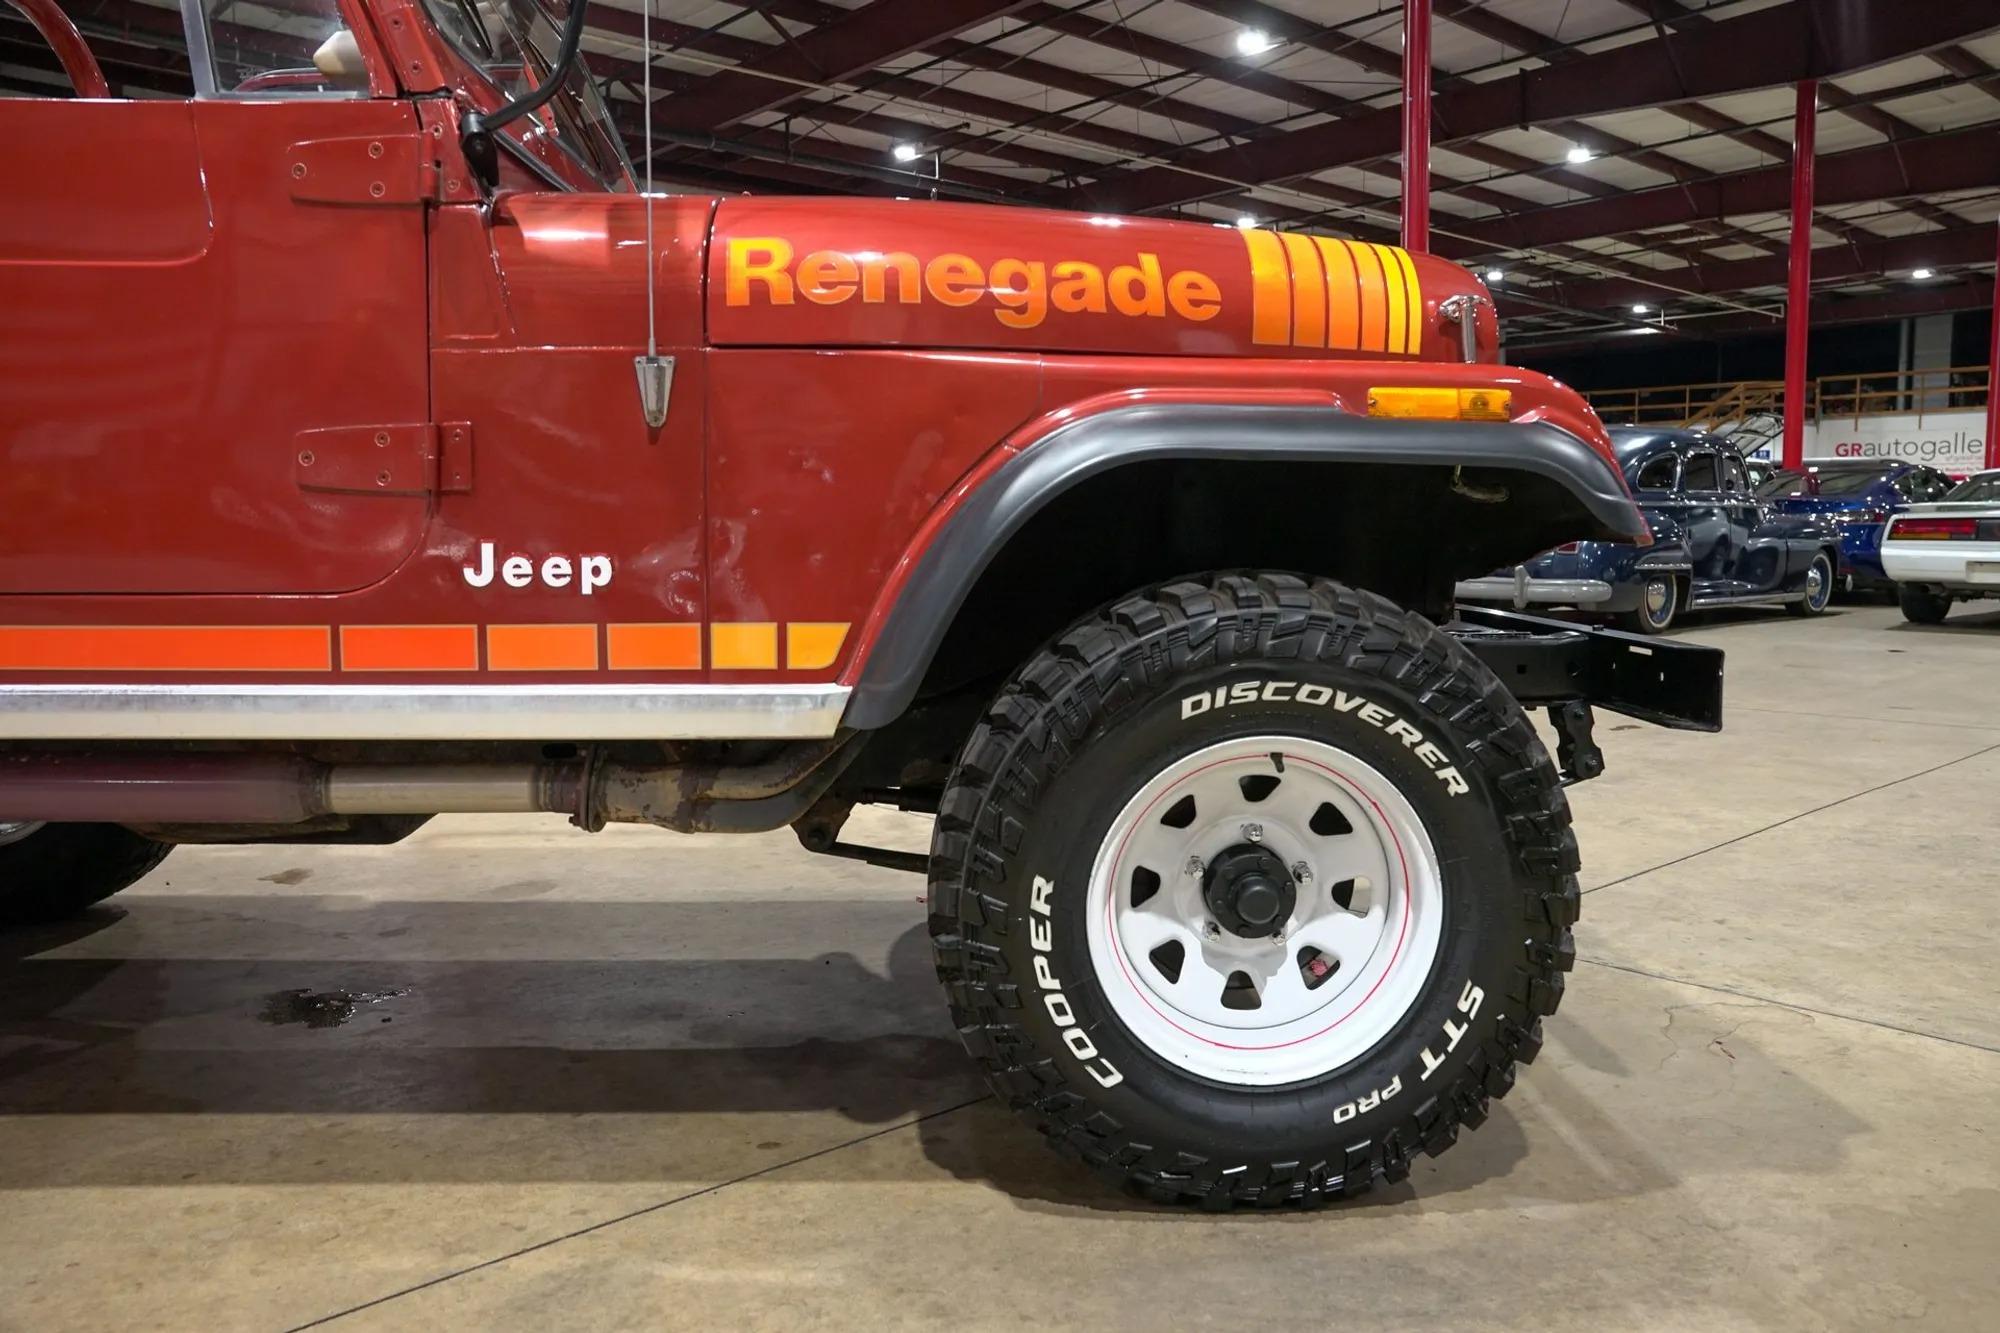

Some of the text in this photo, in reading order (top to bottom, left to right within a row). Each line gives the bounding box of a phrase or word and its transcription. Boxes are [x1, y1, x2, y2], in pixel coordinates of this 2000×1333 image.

[726, 237, 1221, 328] Renegade
[463, 543, 612, 594] Jeep
[1180, 680, 1470, 797] DISCOVERER
[1029, 874, 1124, 1088] COOPER
[1333, 978, 1485, 1124] STT PRO
